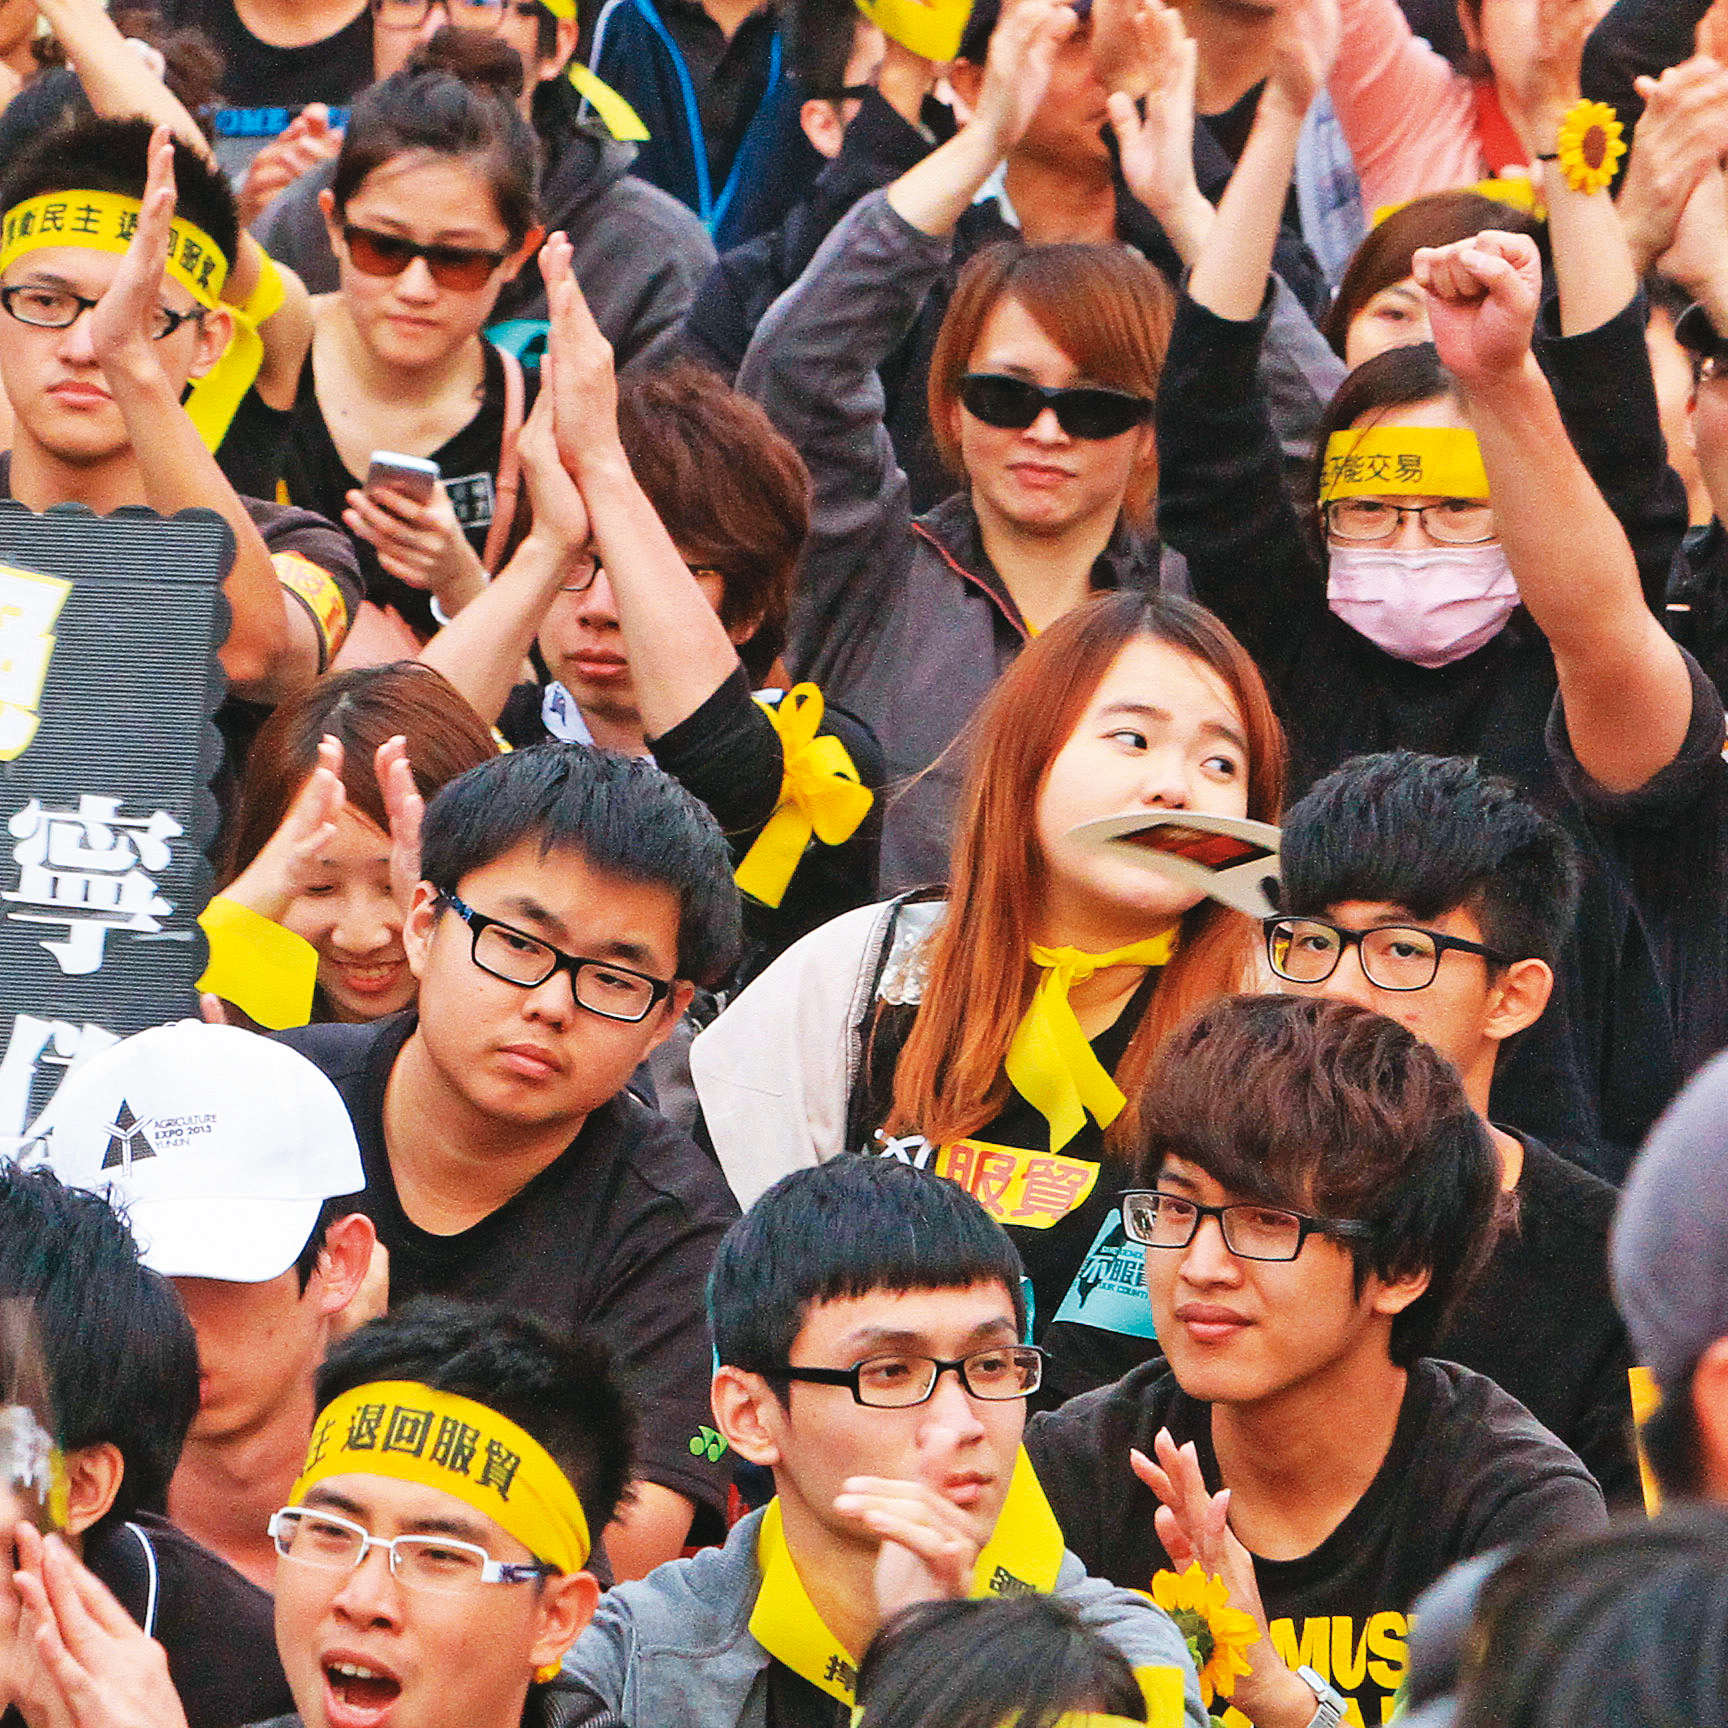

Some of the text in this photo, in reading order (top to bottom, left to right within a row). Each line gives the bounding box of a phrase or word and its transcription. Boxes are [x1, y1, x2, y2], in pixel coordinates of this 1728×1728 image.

[154, 1113, 217, 1130] AGRICULTURE
[155, 1124, 213, 1139] EXPO 2013
[341, 1403, 520, 1502] 退回服貿
